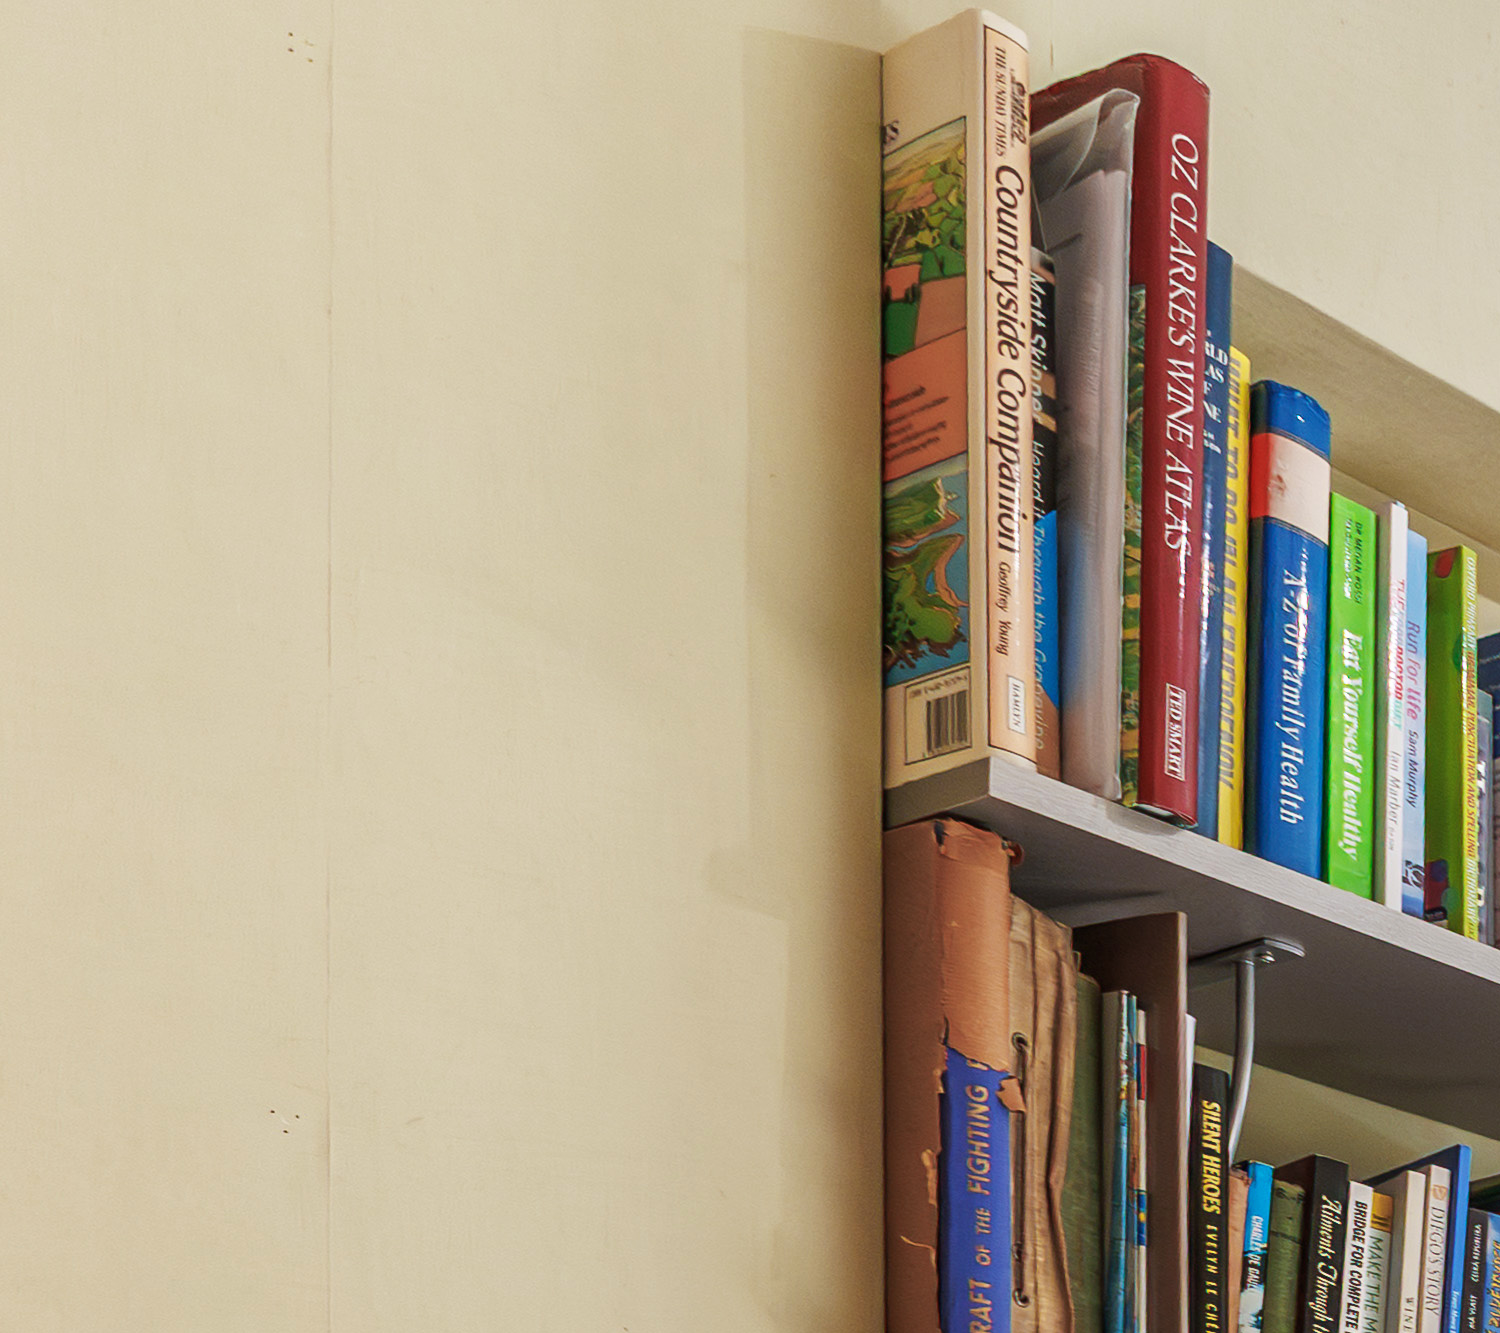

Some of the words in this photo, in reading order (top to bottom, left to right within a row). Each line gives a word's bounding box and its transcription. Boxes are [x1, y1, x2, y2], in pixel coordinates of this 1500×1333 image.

[1170, 133, 1198, 189] OZ
[989, 165, 1026, 360] Countryside
[1169, 191, 1197, 355] CLARKE'S
[1166, 358, 1195, 449] WINE
[989, 372, 1028, 553] Companion
[1164, 450, 1194, 558] ATLAS
[996, 561, 1011, 612] Geoffrey
[996, 621, 1010, 656] Young
[1341, 629, 1364, 671] Eat
[1168, 690, 1183, 720] TED
[1340, 673, 1365, 770] Yourself
[1166, 722, 1182, 776] SMART
[1407, 730, 1419, 755] Sam
[1405, 759, 1419, 808] Murphy
[1336, 771, 1363, 861] Healthy
[966, 1083, 992, 1197] FIGHTING
[1201, 1100, 1221, 1153] SILENT
[1201, 1154, 1221, 1214] HEROES
[974, 1206, 992, 1236] THE
[1319, 1195, 1342, 1258] Ailments
[1352, 1200, 1369, 1244] BRIDGE
[1428, 1206, 1446, 1264] DIEGO'S
[975, 1245, 992, 1267] OF
[1350, 1245, 1365, 1267] FOR
[1308, 1262, 1337, 1322] Through
[1345, 1269, 1363, 1329] COMPLETE
[1425, 1268, 1442, 1315] STORY
